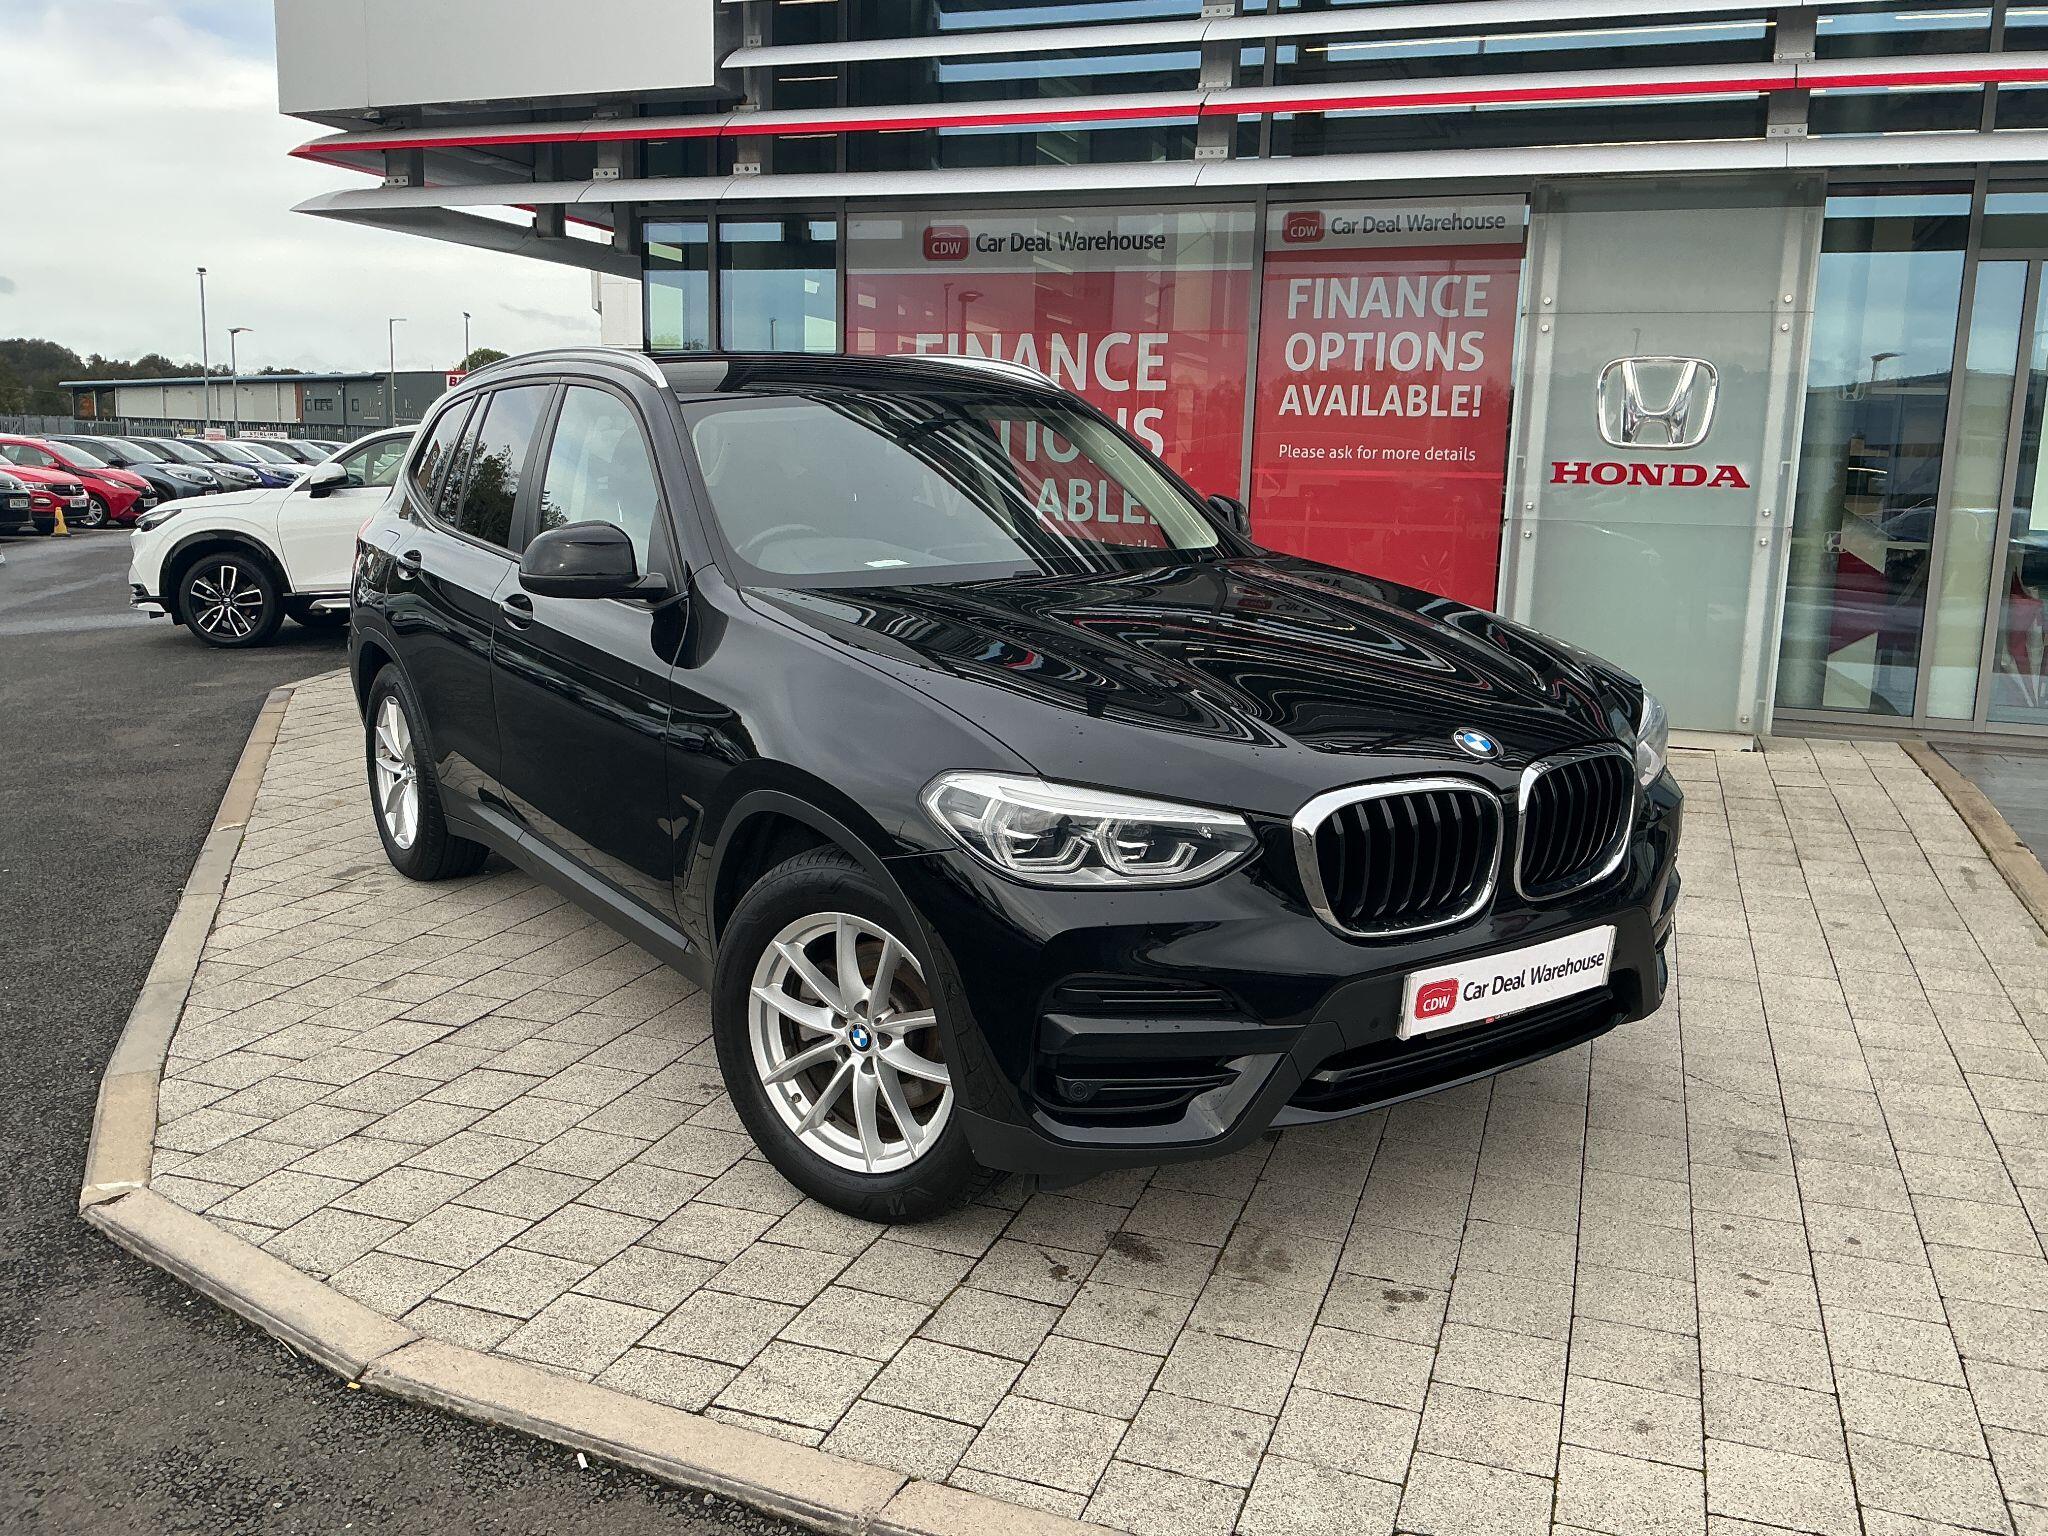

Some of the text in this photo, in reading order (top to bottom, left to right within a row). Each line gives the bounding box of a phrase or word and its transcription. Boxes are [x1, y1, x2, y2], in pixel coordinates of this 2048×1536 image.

[1290, 212, 1506, 238] CDW Car Deal Warehouse
[931, 230, 1166, 255] CDW Car Deal Warehouse
[1287, 275, 1491, 319] FINANCE
[1284, 331, 1485, 372] OPTIONS
[1278, 384, 1482, 418] AVAILABLE!
[1279, 444, 1476, 461] Please ask for more details
[1550, 461, 1751, 488] HONDA
[1422, 952, 1605, 1012] CDW Car Deal Warehouse
